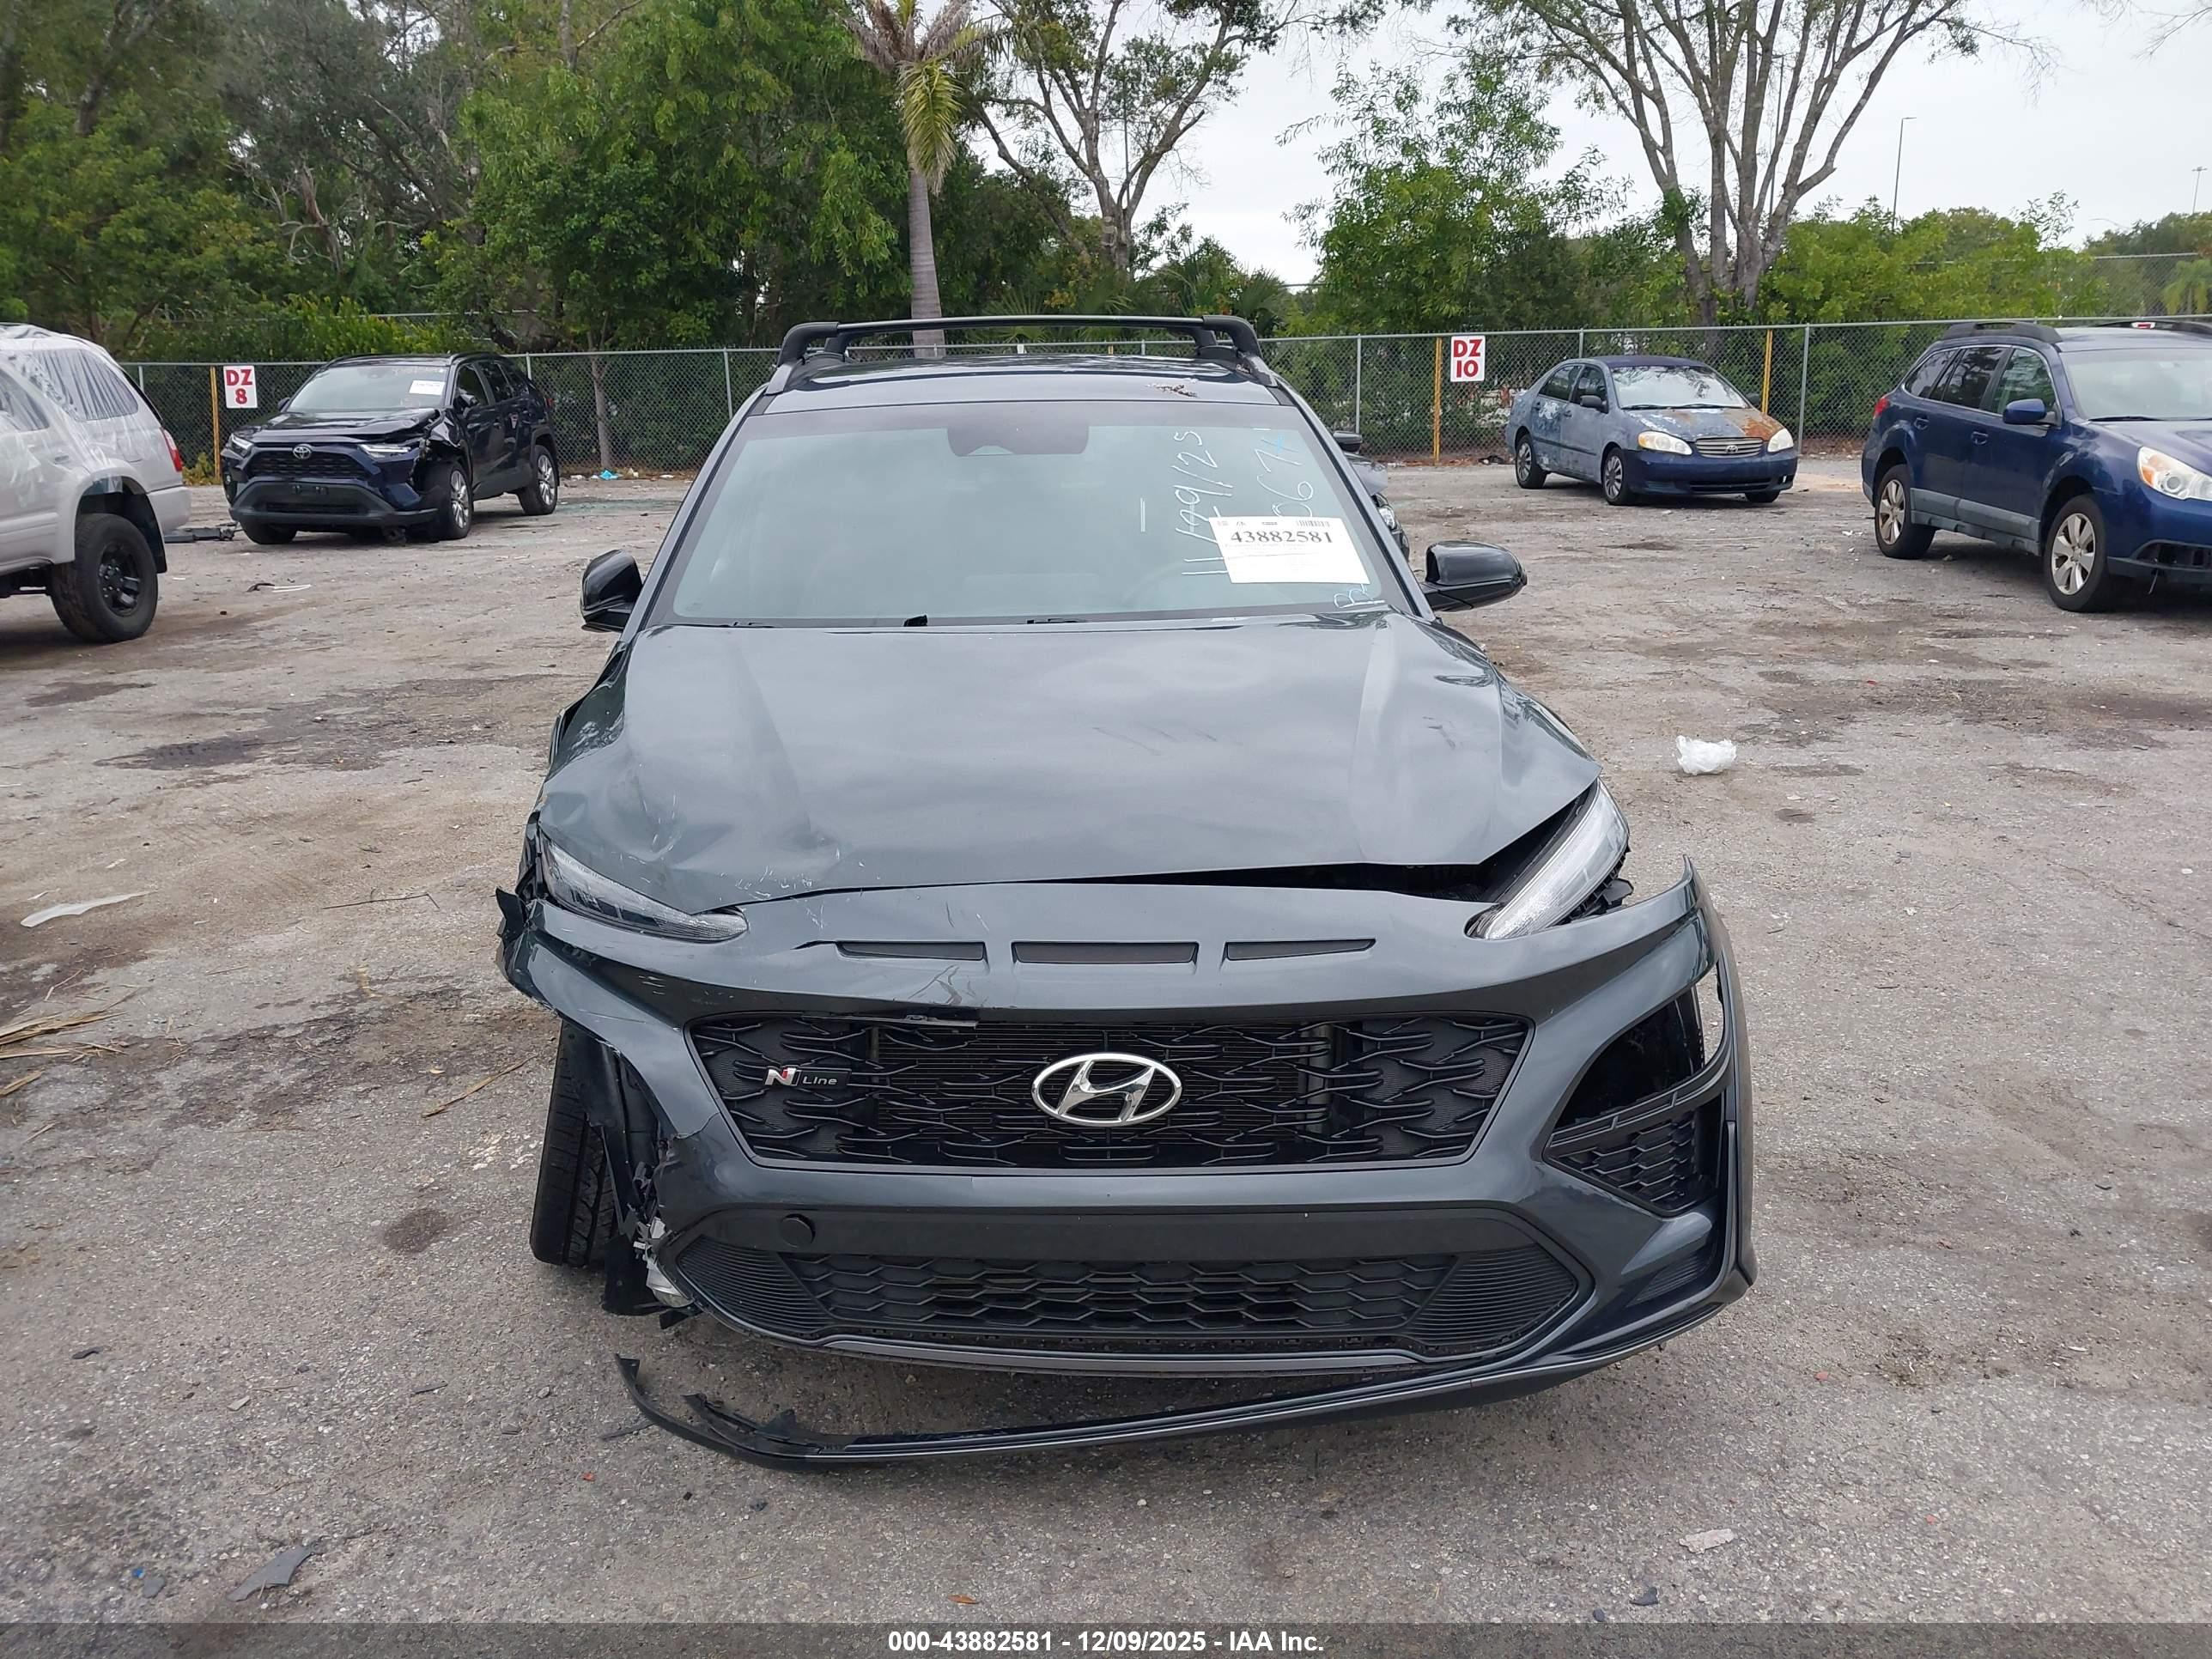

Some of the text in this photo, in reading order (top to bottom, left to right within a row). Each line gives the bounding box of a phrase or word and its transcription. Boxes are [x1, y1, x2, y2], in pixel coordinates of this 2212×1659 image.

[1453, 338, 1483, 358] DZ
[225, 368, 253, 386] DZ
[1455, 359, 1479, 378] 10
[235, 387, 248, 404] 8
[1230, 530, 1334, 544] 43882581
[802, 1076, 838, 1085] Line
